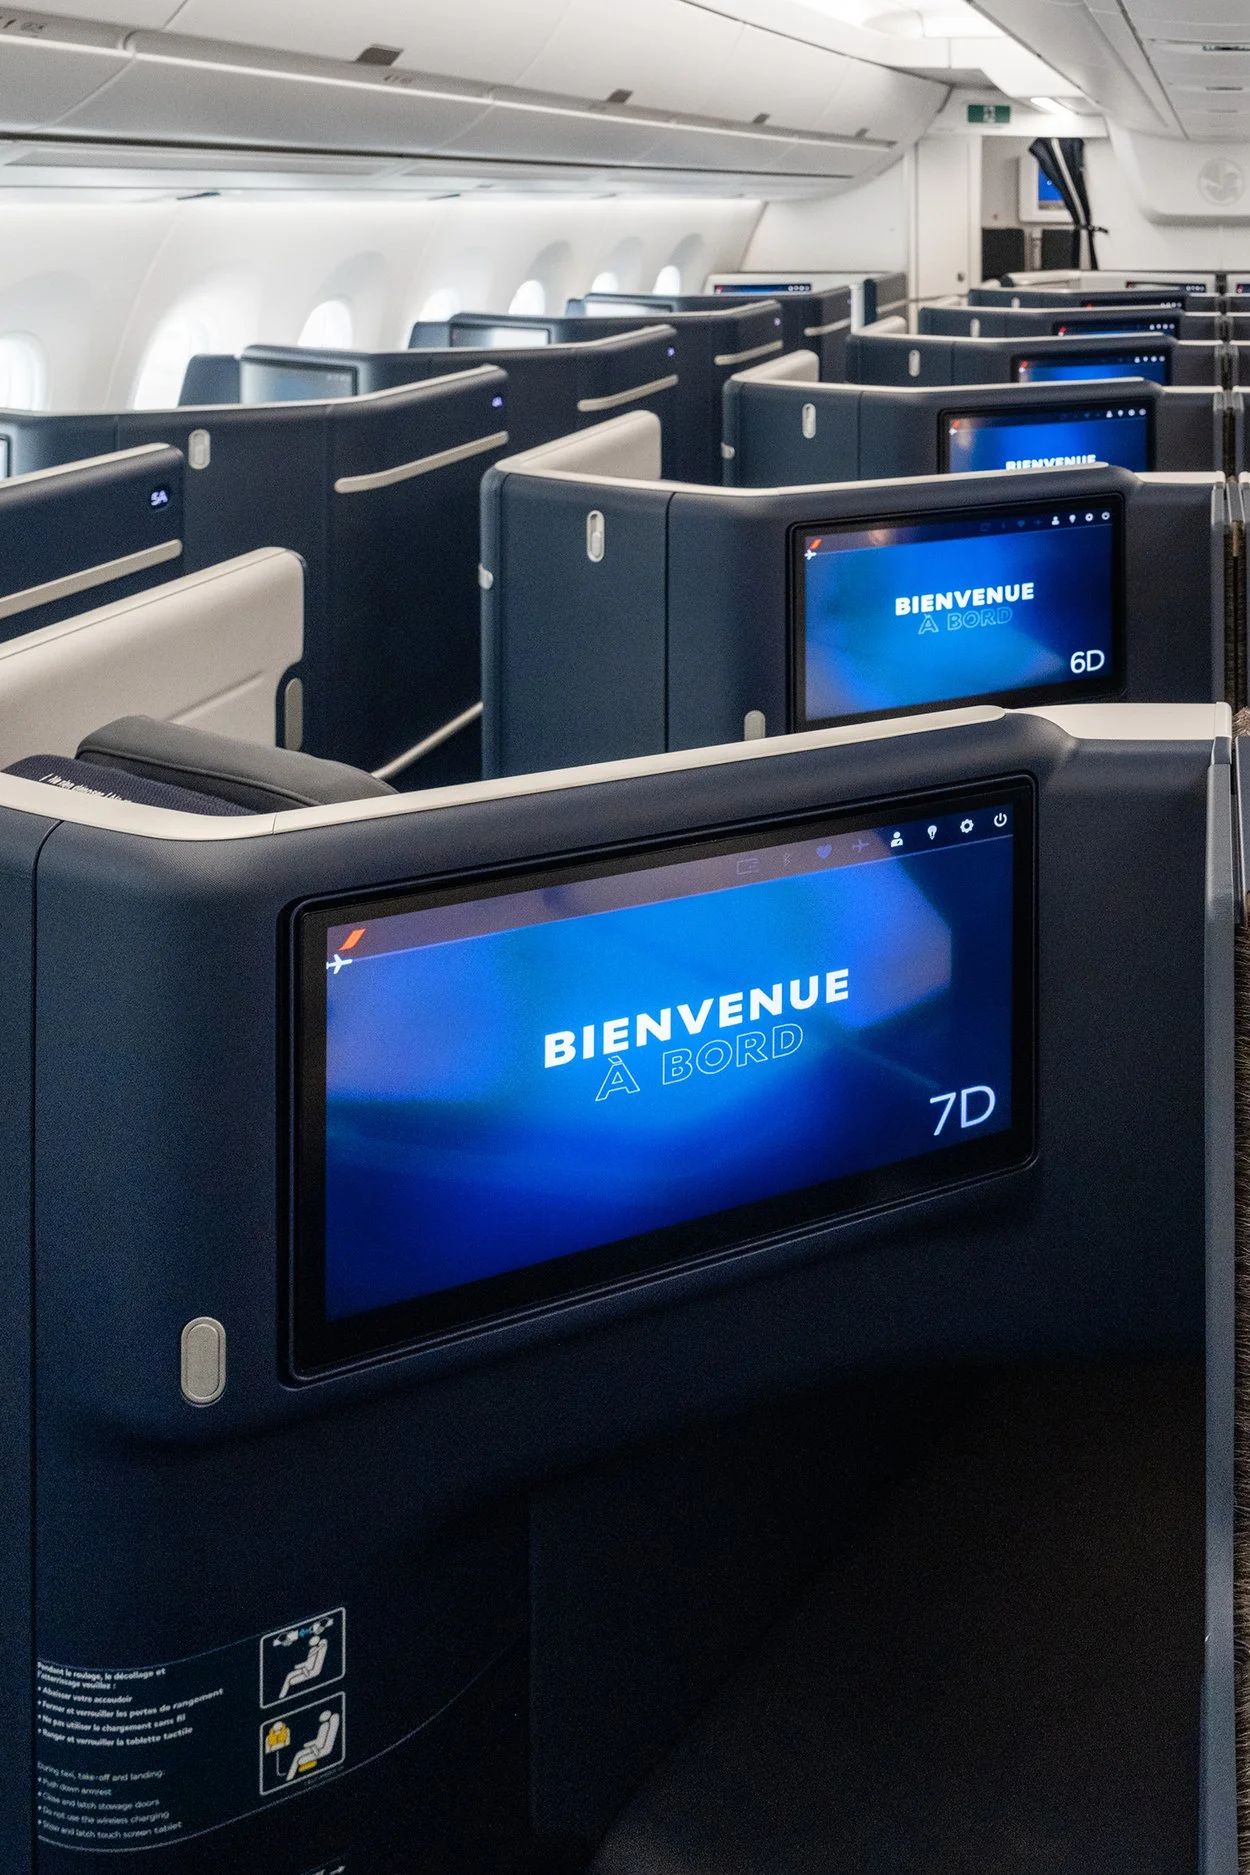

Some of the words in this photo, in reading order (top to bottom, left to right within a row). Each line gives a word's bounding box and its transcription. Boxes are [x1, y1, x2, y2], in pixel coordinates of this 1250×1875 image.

[1005, 454, 1096, 470] BIENVENUE
[895, 582, 1035, 616] BIENVENUE
[918, 614, 939, 635] À
[947, 606, 1013, 631] BORD
[1070, 649, 1105, 674] 6D
[544, 968, 849, 1069] BIENVENUE
[595, 1055, 641, 1102] À
[662, 1023, 803, 1085] BORD
[929, 1085, 996, 1136] 7D
